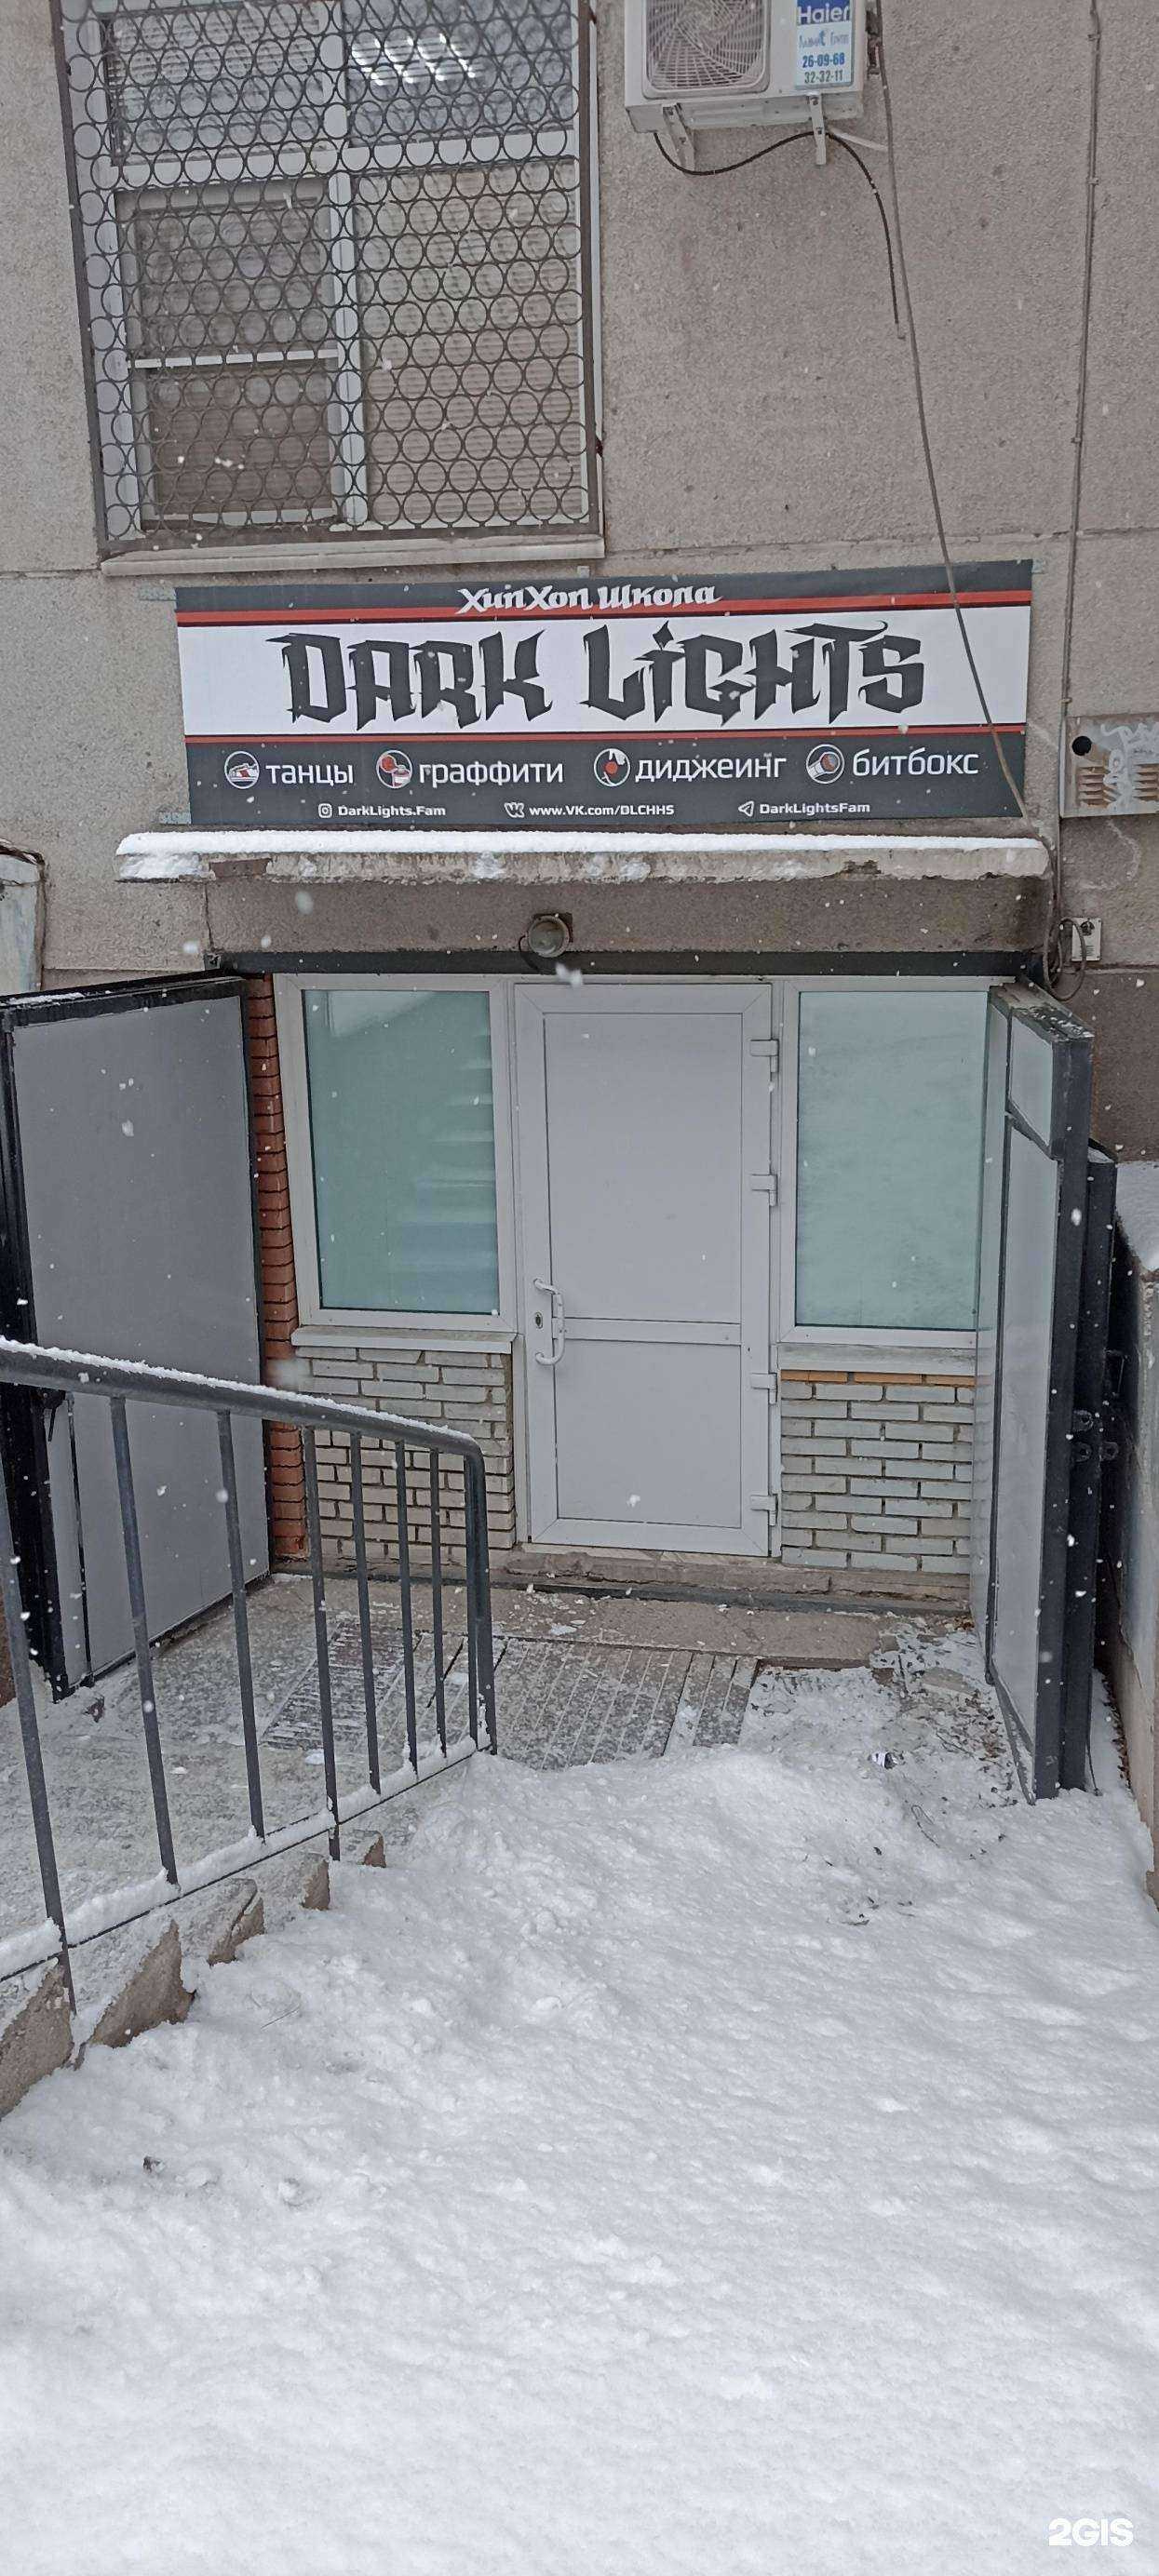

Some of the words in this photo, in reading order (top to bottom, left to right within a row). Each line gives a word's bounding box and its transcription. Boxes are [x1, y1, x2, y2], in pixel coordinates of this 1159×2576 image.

[798, 3, 850, 24] Haier
[802, 52, 845, 68] 26-09-68
[804, 70, 843, 83] 32-32-11
[598, 584, 723, 610] Школа
[266, 630, 553, 731] DARK
[635, 758, 788, 782] диджеинг
[853, 748, 978, 776] битбокс
[265, 763, 354, 785] танцы
[419, 760, 564, 786] граффити
[338, 804, 446, 817] DarkLights.Fam
[529, 803, 675, 817] www.VK.com/DLCHHS
[759, 802, 870, 815] DarkLightsFam
